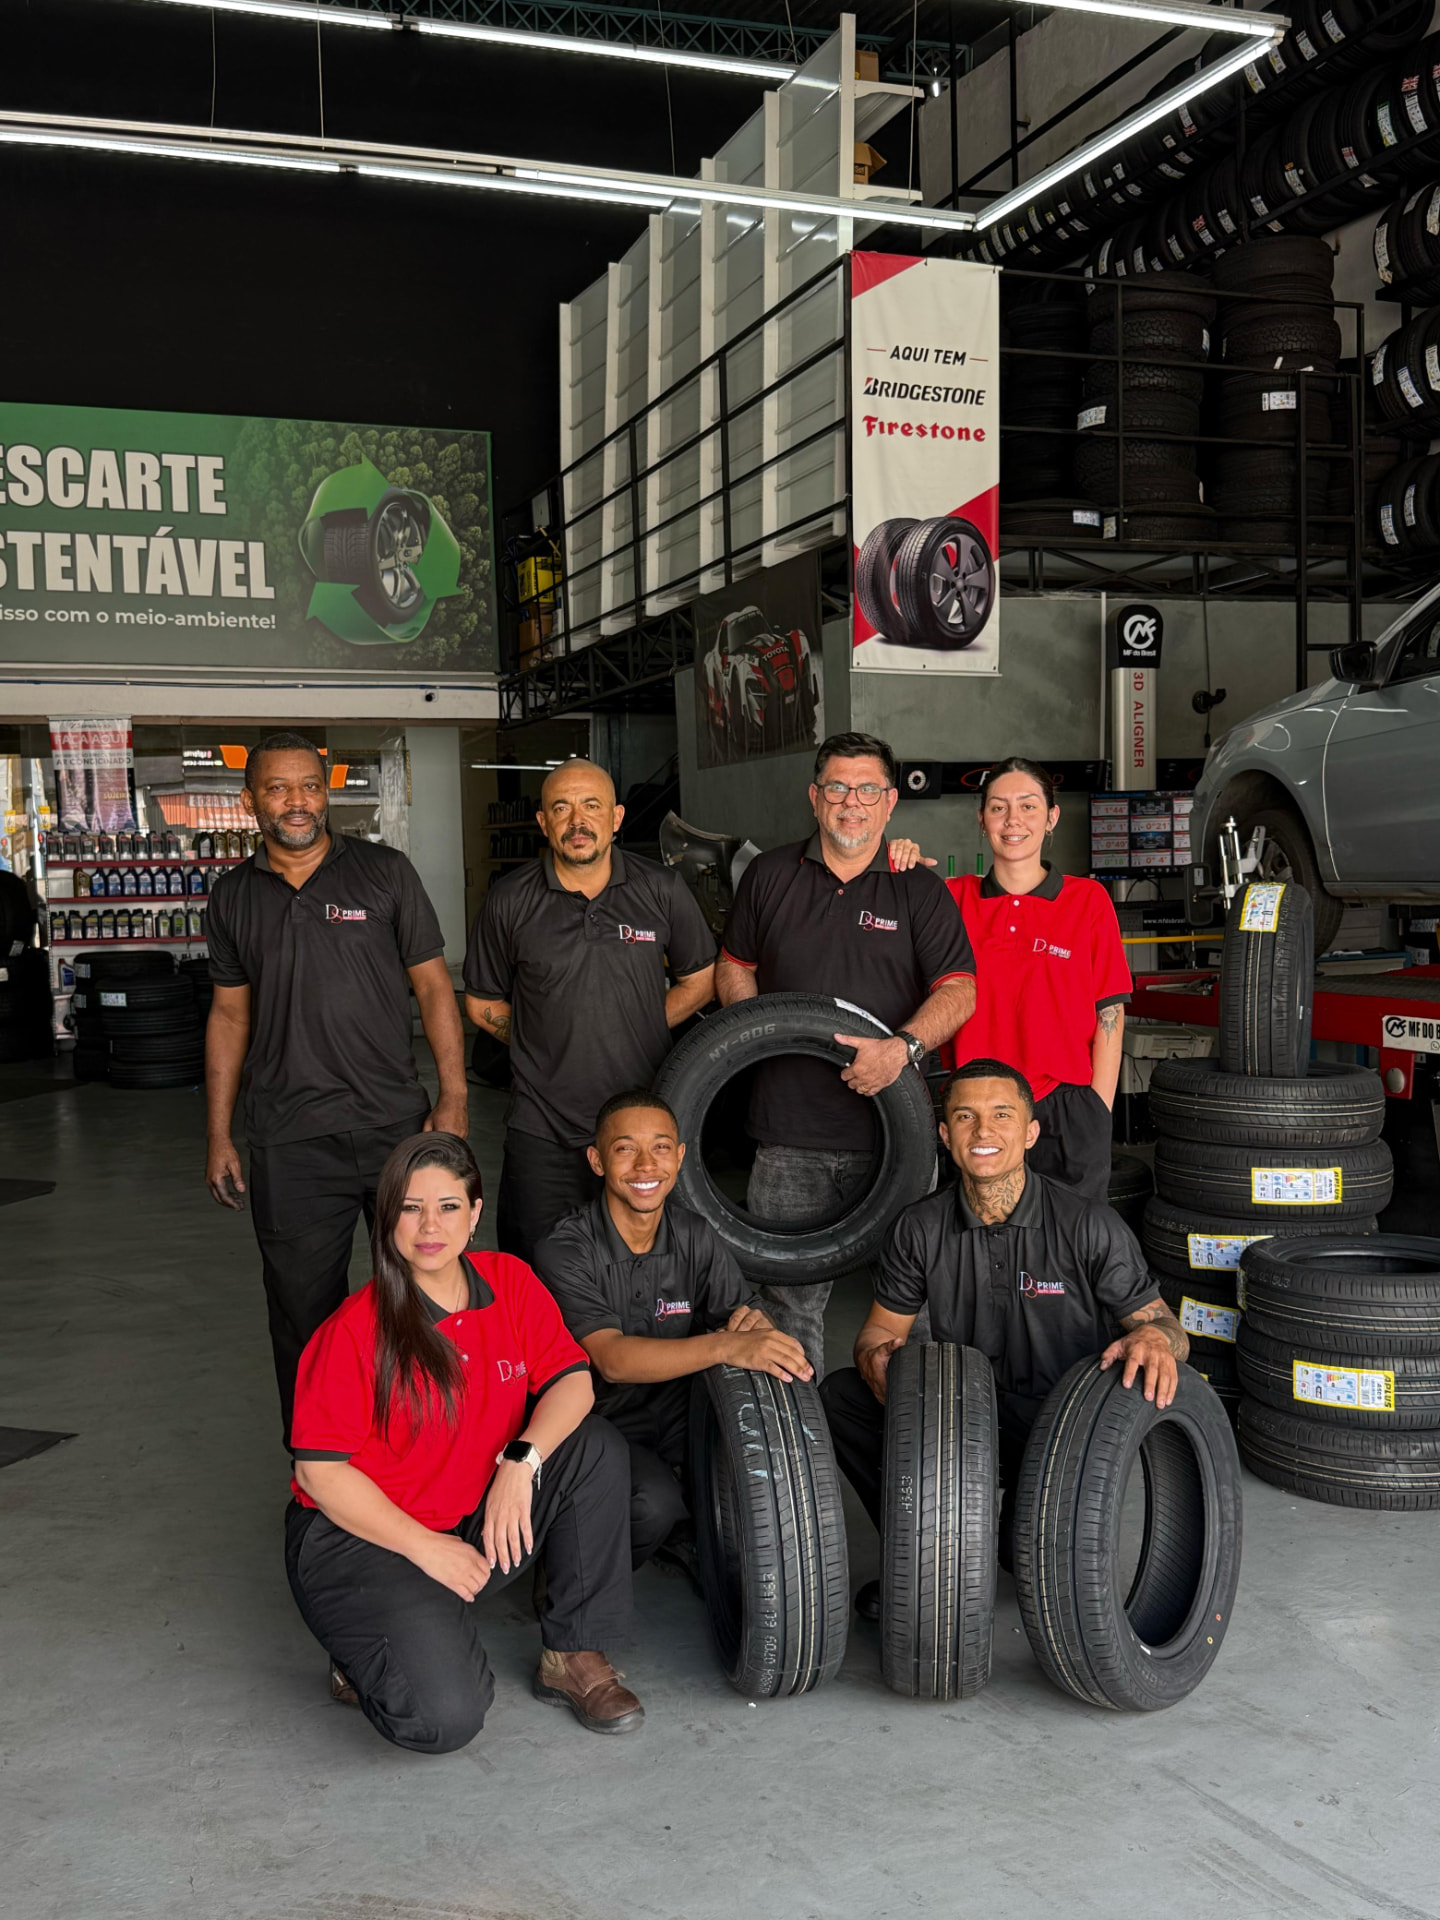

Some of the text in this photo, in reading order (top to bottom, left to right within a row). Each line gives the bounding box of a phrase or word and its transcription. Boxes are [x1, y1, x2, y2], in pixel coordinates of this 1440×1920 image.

[889, 345, 967, 366] AQUI TEM
[863, 377, 986, 405] BRIDGESTONE
[862, 415, 986, 443] Firestone
[0, 444, 228, 516] SCARTE
[0, 525, 276, 600] TENTÁVEL
[44, 610, 90, 623] com
[97, 612, 109, 624] o
[115, 609, 276, 629] meio-ambiente!
[762, 646, 790, 661] TOYOTA
[1133, 672, 1145, 768] 3D ALIGNER
[54, 735, 89, 747] FAÇA
[342, 909, 367, 917] PRIME
[875, 917, 898, 928] PRIME
[1408, 1020, 1420, 1038] MF
[1422, 1022, 1434, 1039] DO
[1037, 1281, 1065, 1290] PRIME
[666, 1301, 691, 1310] PRIME
[1384, 1374, 1392, 1408] APLUS
